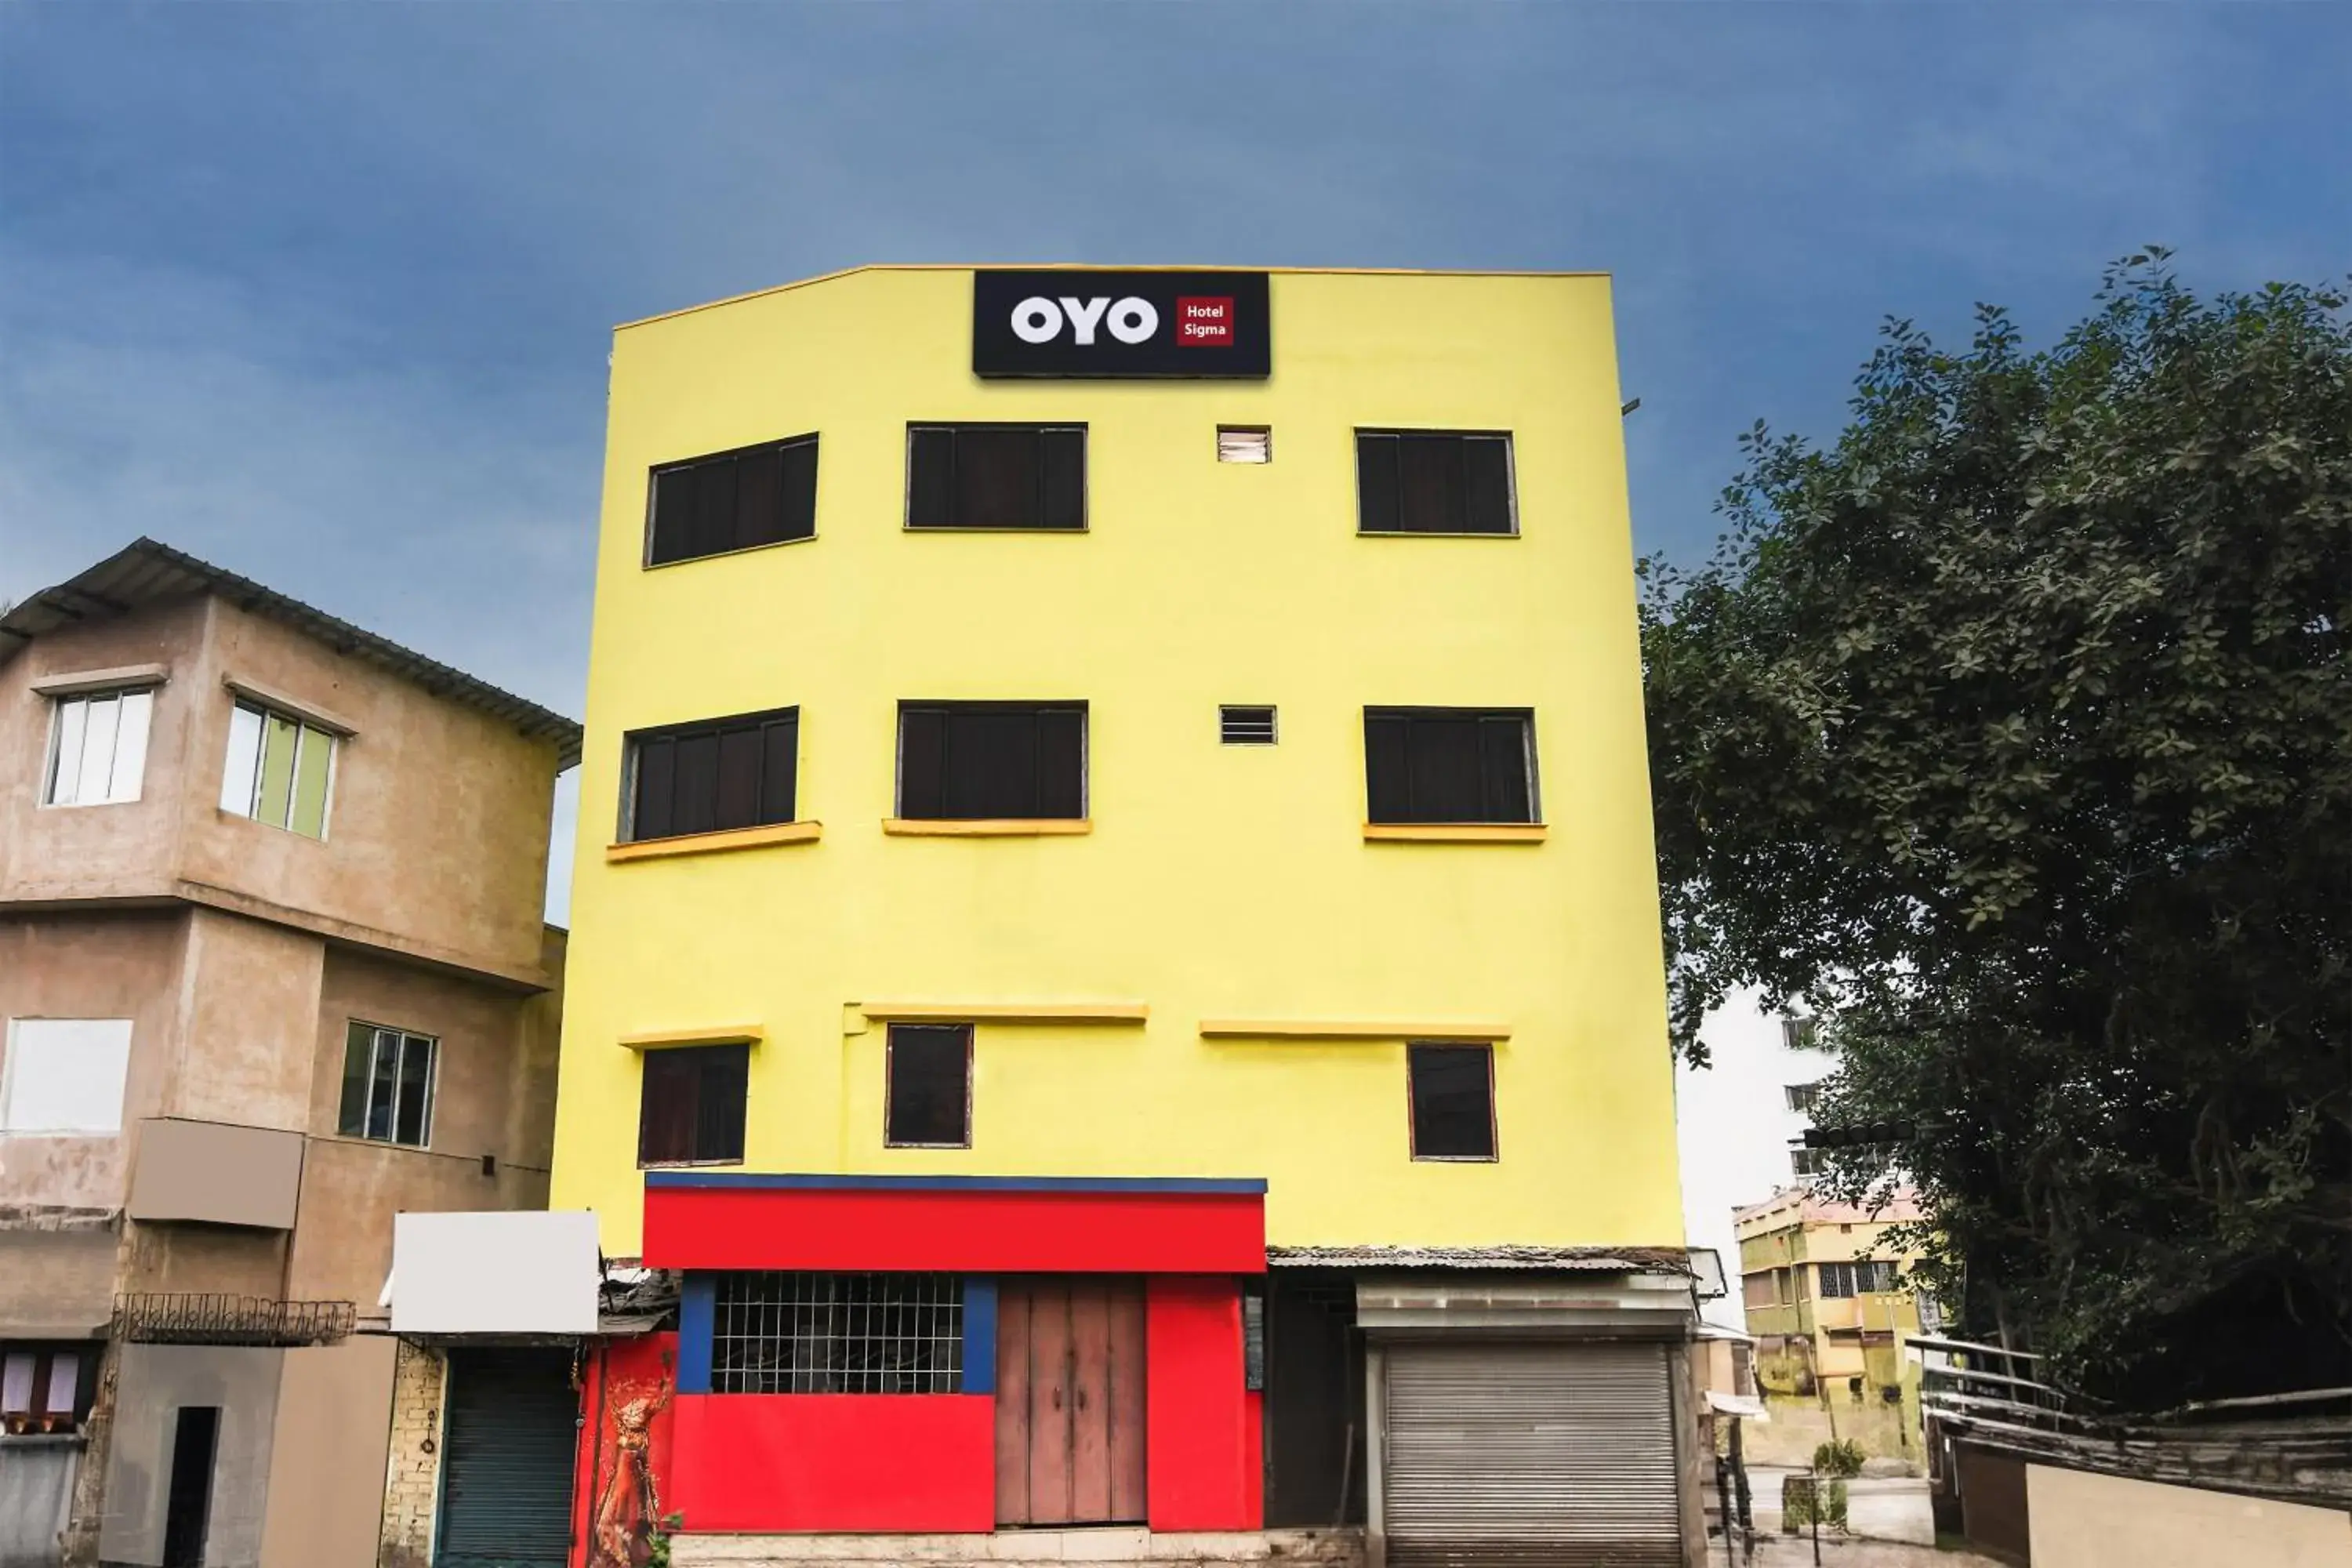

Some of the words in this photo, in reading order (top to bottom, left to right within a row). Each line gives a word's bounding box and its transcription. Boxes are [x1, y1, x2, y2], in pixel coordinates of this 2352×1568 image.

[1188, 305, 1224, 318] Hotel
[1011, 296, 1159, 345] OYO
[1185, 323, 1226, 338] Sigma
